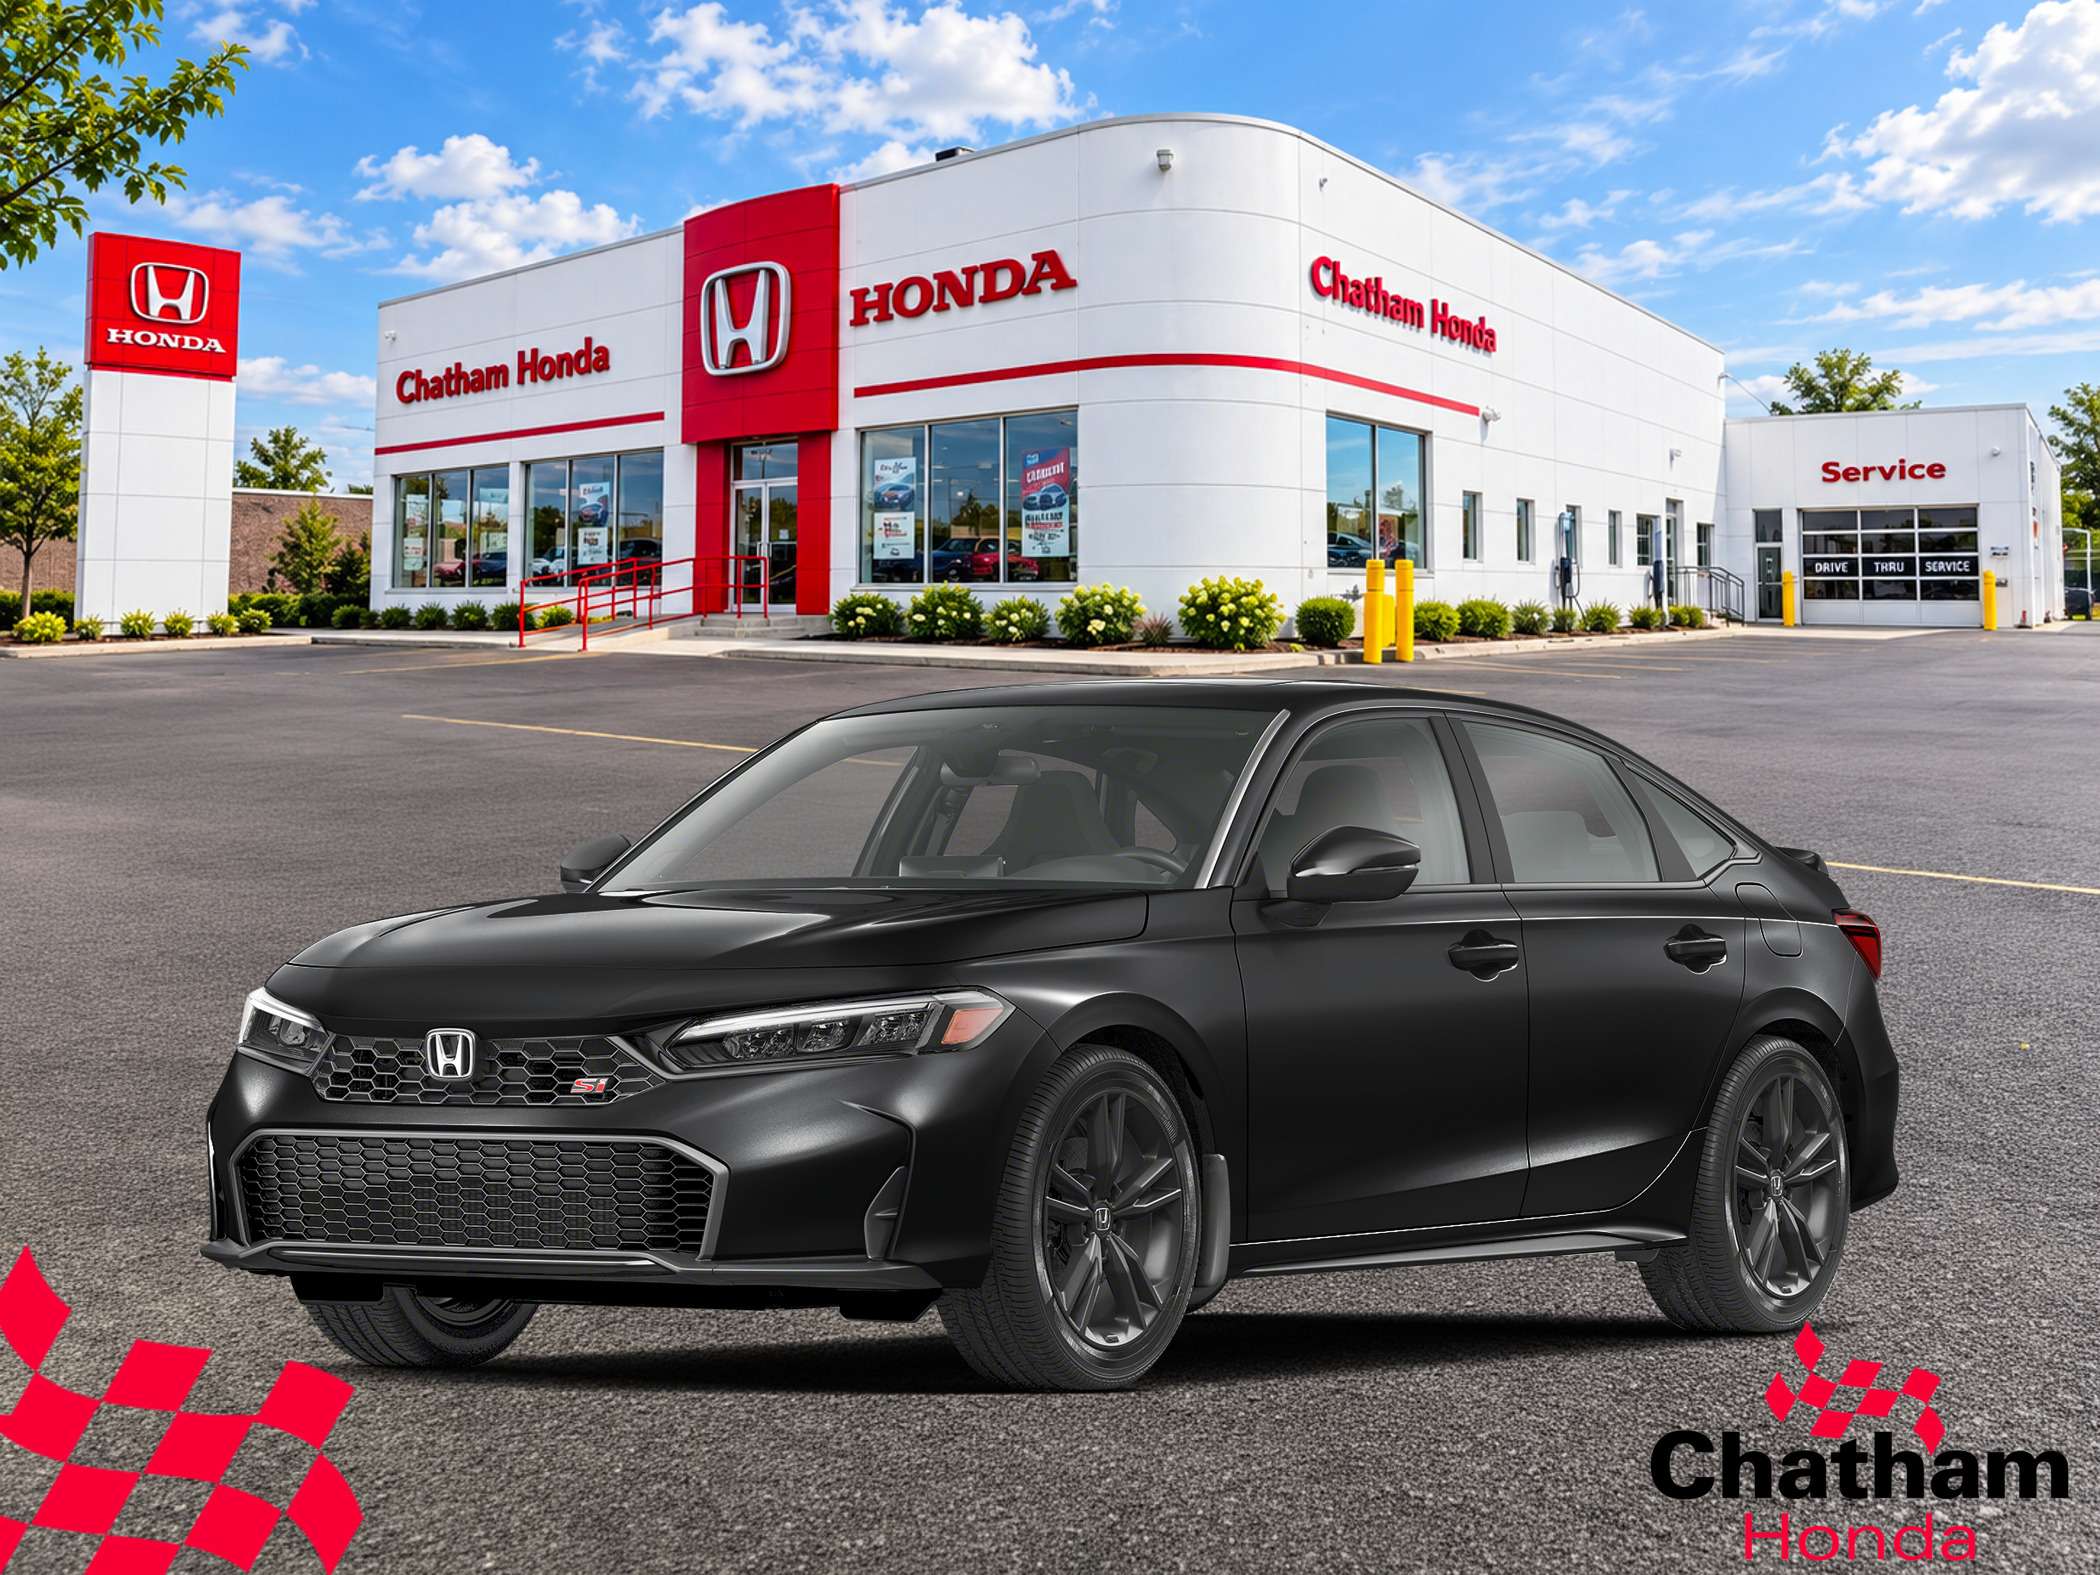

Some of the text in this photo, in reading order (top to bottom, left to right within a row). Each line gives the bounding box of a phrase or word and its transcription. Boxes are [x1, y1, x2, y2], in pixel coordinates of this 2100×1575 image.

[849, 248, 1077, 327] HONDA
[1310, 255, 1497, 353] Chatham Honda
[107, 327, 227, 354] HONDA
[396, 336, 610, 404] Chatham Honda
[1821, 458, 1946, 483] Service
[1814, 561, 1849, 573] DRIVE
[1924, 560, 1971, 573] SERVICE
